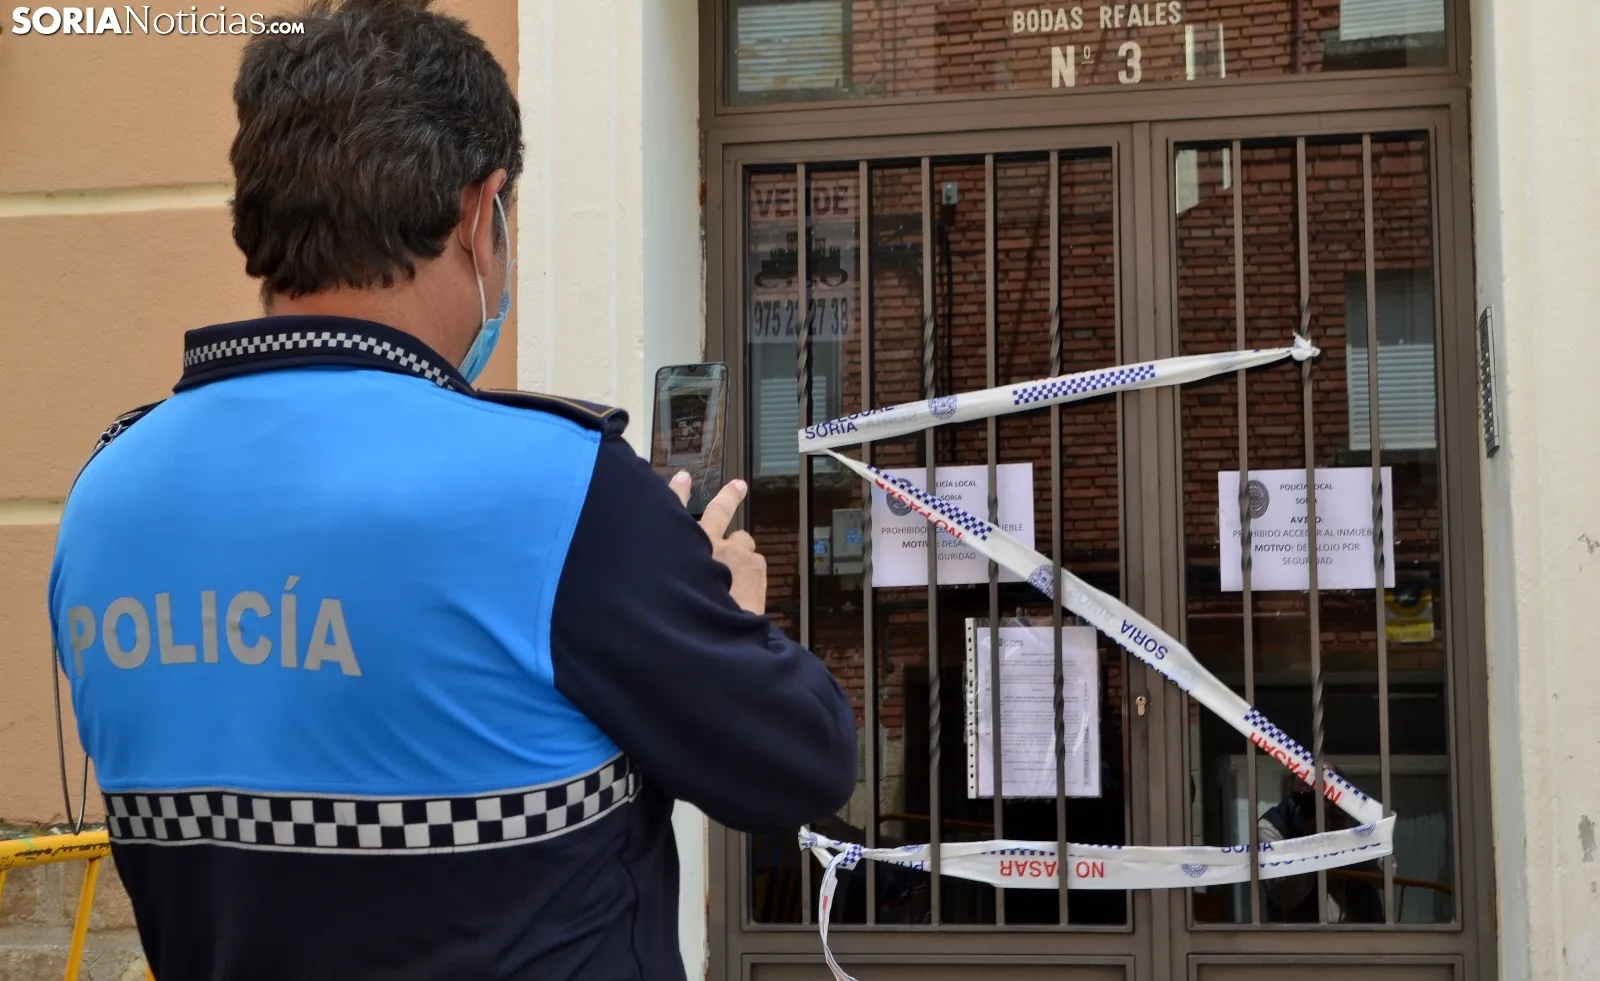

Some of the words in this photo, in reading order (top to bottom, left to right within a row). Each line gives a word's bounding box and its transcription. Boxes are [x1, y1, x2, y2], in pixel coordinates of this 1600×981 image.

[1012, 6, 1083, 33] BODAS
[1118, 41, 1142, 84] 3
[754, 300, 781, 337] 975
[1314, 483, 1334, 491] OCAL
[1290, 516, 1324, 524] AVIO:
[881, 526, 928, 535] PROHIBIDO
[1232, 529, 1281, 538] PRHIBIDO
[1283, 528, 1322, 538] ACCER
[1325, 528, 1336, 537] AL
[1337, 528, 1374, 537] INMUEB
[902, 540, 940, 549] MOTIV:
[1254, 543, 1295, 552] MOTIVO:
[1296, 543, 1340, 551] DELOJO
[1342, 543, 1360, 551] POR
[938, 552, 977, 561] GURIDAD
[1282, 556, 1333, 566] SEGUDAD
[68, 575, 362, 678] POLICÍA
[1120, 619, 1169, 660] SORIA
[1000, 860, 1058, 878] ASAR
[1075, 861, 1105, 878] NO
